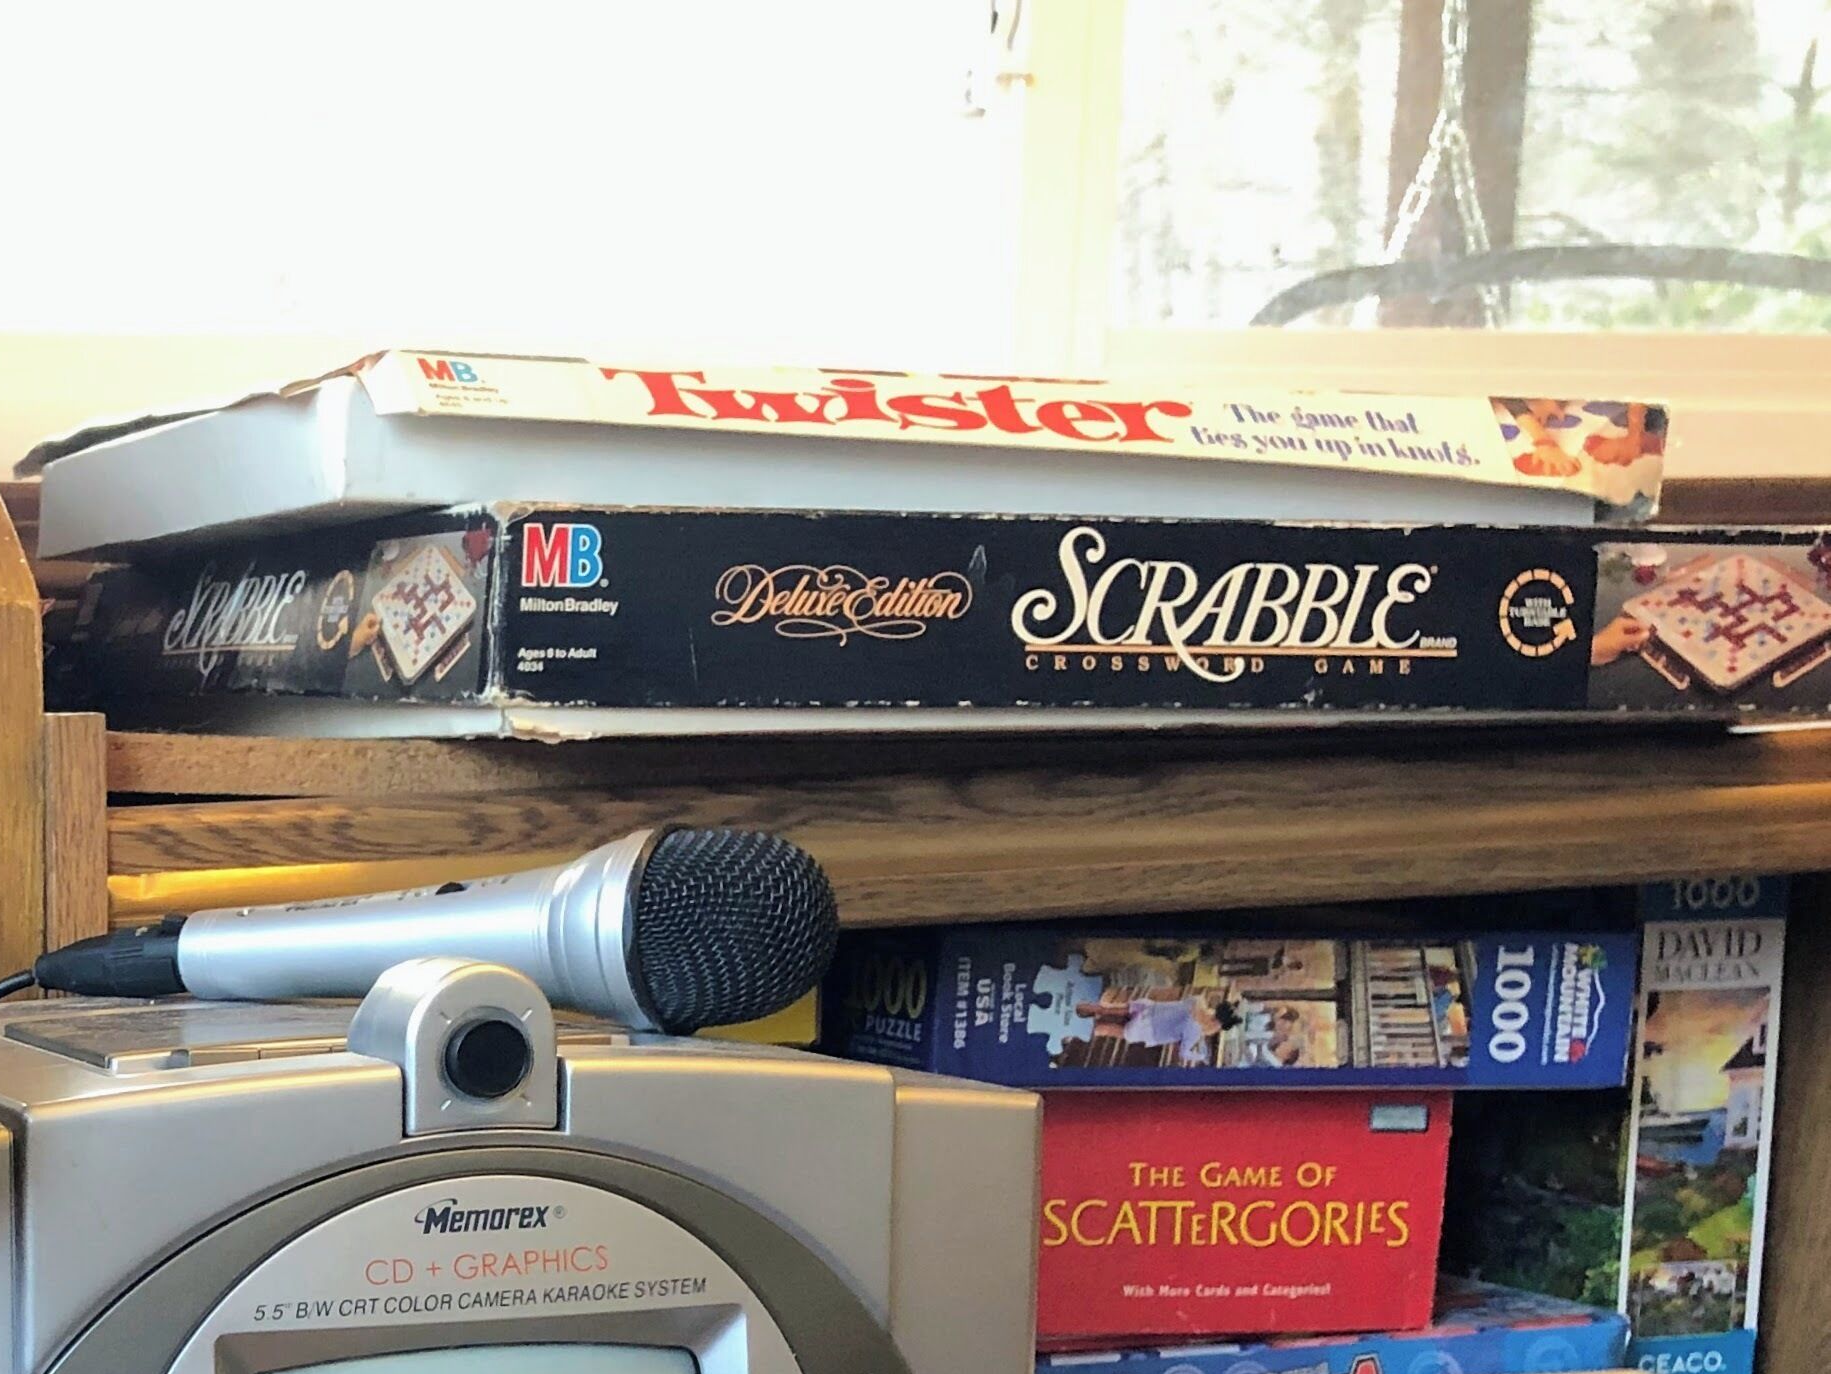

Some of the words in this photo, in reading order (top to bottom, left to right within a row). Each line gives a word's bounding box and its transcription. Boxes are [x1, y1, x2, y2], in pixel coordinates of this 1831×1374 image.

[417, 358, 478, 382] MB
[601, 366, 1195, 444] Twister
[1224, 403, 1281, 424] The
[1291, 406, 1359, 432] game
[1365, 410, 1420, 434] that
[1190, 425, 1248, 449] ties
[1252, 433, 1308, 454] you
[1315, 437, 1353, 462] up
[1355, 436, 1387, 458] in
[1387, 438, 1481, 467] knots.
[522, 522, 604, 588] MB
[711, 565, 844, 625] Deluxe
[840, 571, 972, 632] Edition
[1011, 527, 1432, 682] SCRABBLE
[518, 648, 545, 660] Ages
[568, 648, 597, 659] Adult
[1314, 657, 1411, 675] GAME
[1658, 927, 1762, 959] DAVID
[956, 956, 971, 996] ITEM
[974, 978, 991, 1027] USA
[1014, 983, 1027, 1023] Local
[1489, 944, 1535, 1063] 1000
[1554, 942, 1579, 1063] MOUNTAIN
[1570, 969, 1592, 1039] WHITE
[865, 1015, 922, 1042] PUZZLE
[998, 1003, 1012, 1044] Store
[415, 1199, 547, 1234] Memorex
[1043, 1199, 1409, 1247] SCATTERGORIES
[366, 1257, 413, 1286] CD
[454, 1245, 609, 1280] GRAPHICS
[338, 1297, 379, 1318] CRT
[383, 1293, 453, 1314] COLOR
[457, 1288, 538, 1311] CAMERA
[542, 1281, 630, 1305] KARAOKE
[633, 1277, 707, 1301] SYSTEM
[1123, 1284, 1154, 1298] With
[1159, 1284, 1191, 1297] More
[1196, 1284, 1230, 1297] Cards
[1235, 1284, 1259, 1297] and
